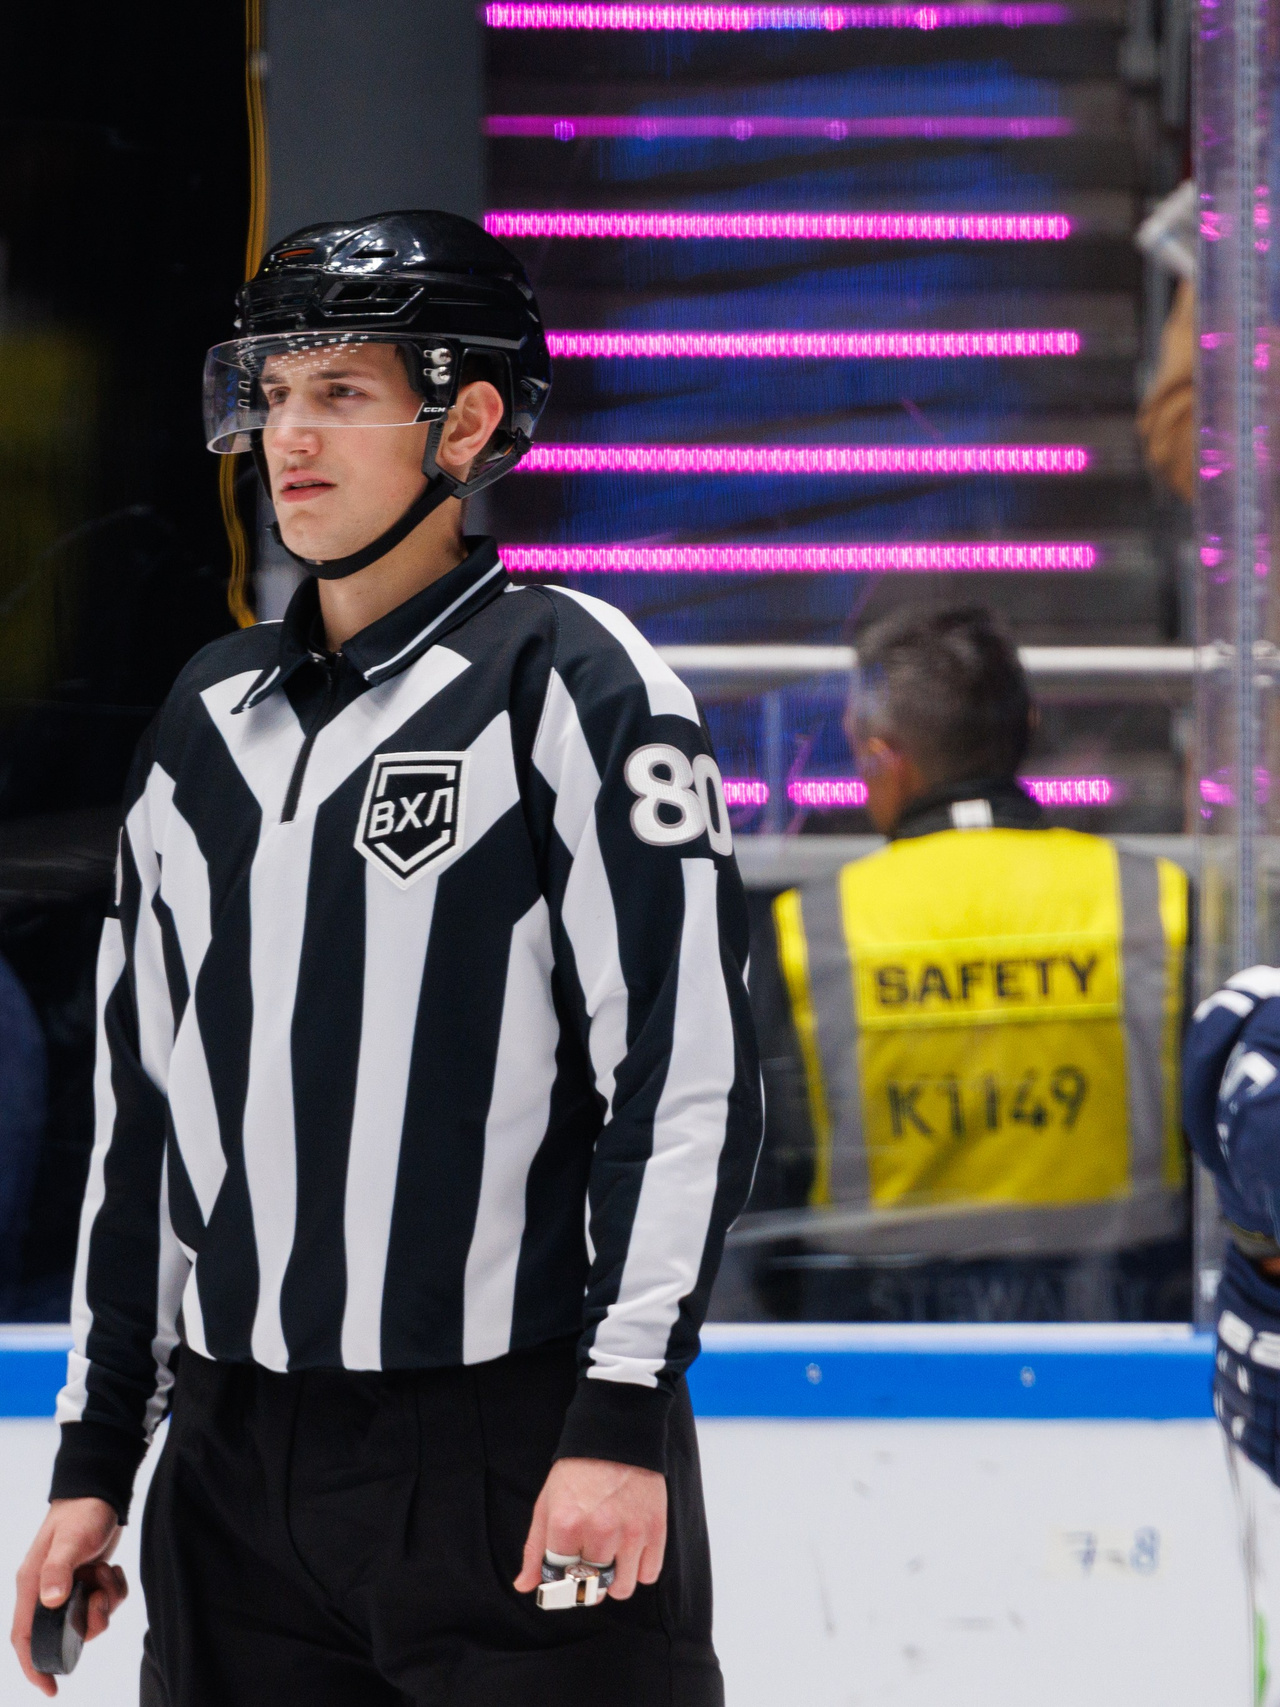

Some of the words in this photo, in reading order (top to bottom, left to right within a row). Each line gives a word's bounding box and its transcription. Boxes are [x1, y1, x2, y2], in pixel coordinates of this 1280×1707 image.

[368, 787, 454, 839] ВХЛ
[624, 743, 732, 856] 80
[875, 954, 1098, 1005] SAFETY
